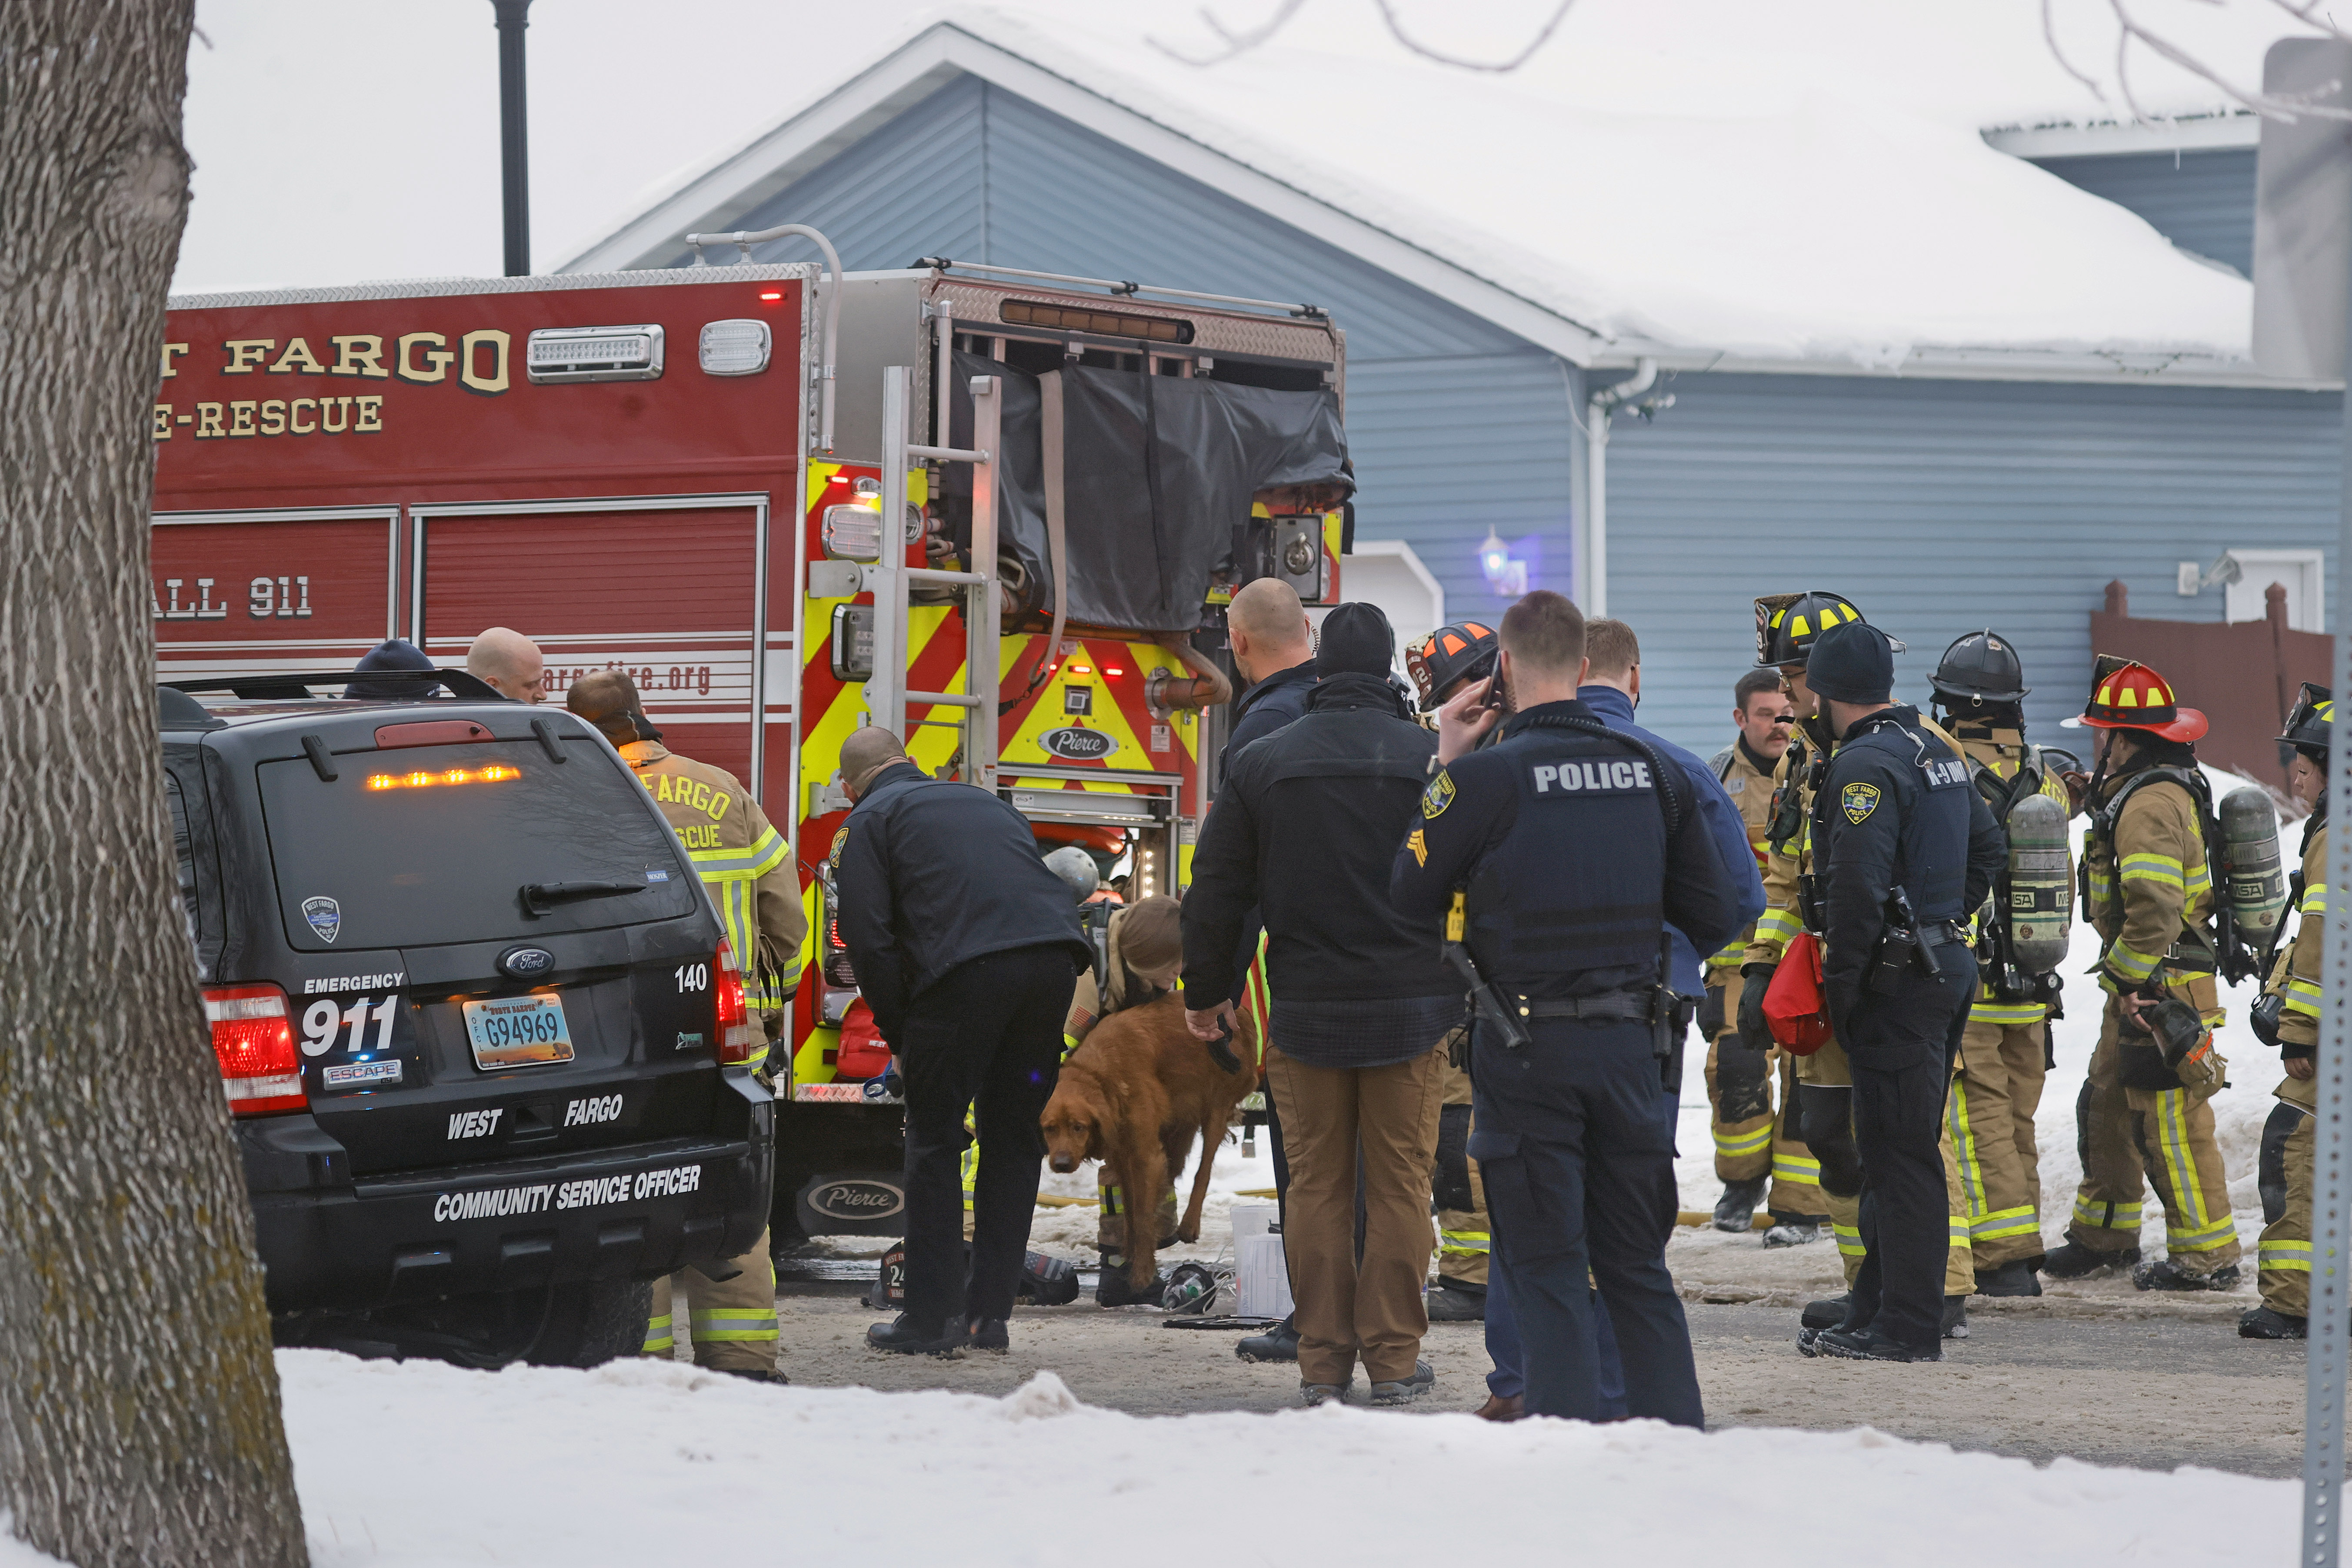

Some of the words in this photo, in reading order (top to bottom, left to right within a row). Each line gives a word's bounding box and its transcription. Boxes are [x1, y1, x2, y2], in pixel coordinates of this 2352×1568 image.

[223, 329, 511, 393] FARGO
[153, 396, 382, 439] E-RESCUE
[250, 576, 312, 617] 911
[1056, 731, 1101, 752] Pierce
[1533, 762, 1652, 793] POLICE
[639, 774, 731, 821] FARGO
[1846, 786, 1859, 794] WEST
[1860, 786, 1877, 796] FARGO
[674, 825, 723, 849] SCUE
[305, 901, 319, 912] WEST
[318, 900, 334, 909] FARGO
[319, 926, 336, 935] POLICE
[520, 953, 544, 969] Ford
[304, 972, 404, 994] EMERGENCY
[675, 963, 707, 993] 140
[489, 1006, 511, 1015] NORTH
[512, 1004, 536, 1013] DAKOTA
[300, 995, 398, 1057] 911
[485, 1012, 557, 1047] G94969
[330, 1064, 396, 1081] ESCAPE
[447, 1109, 503, 1140] WEST
[564, 1094, 623, 1127] FARGO
[435, 1184, 556, 1222] COMMUNITY
[556, 1175, 632, 1209] SERVICE
[634, 1165, 701, 1200] OFFICER
[826, 1187, 889, 1208] Pierce
[885, 1254, 897, 1265] WEST
